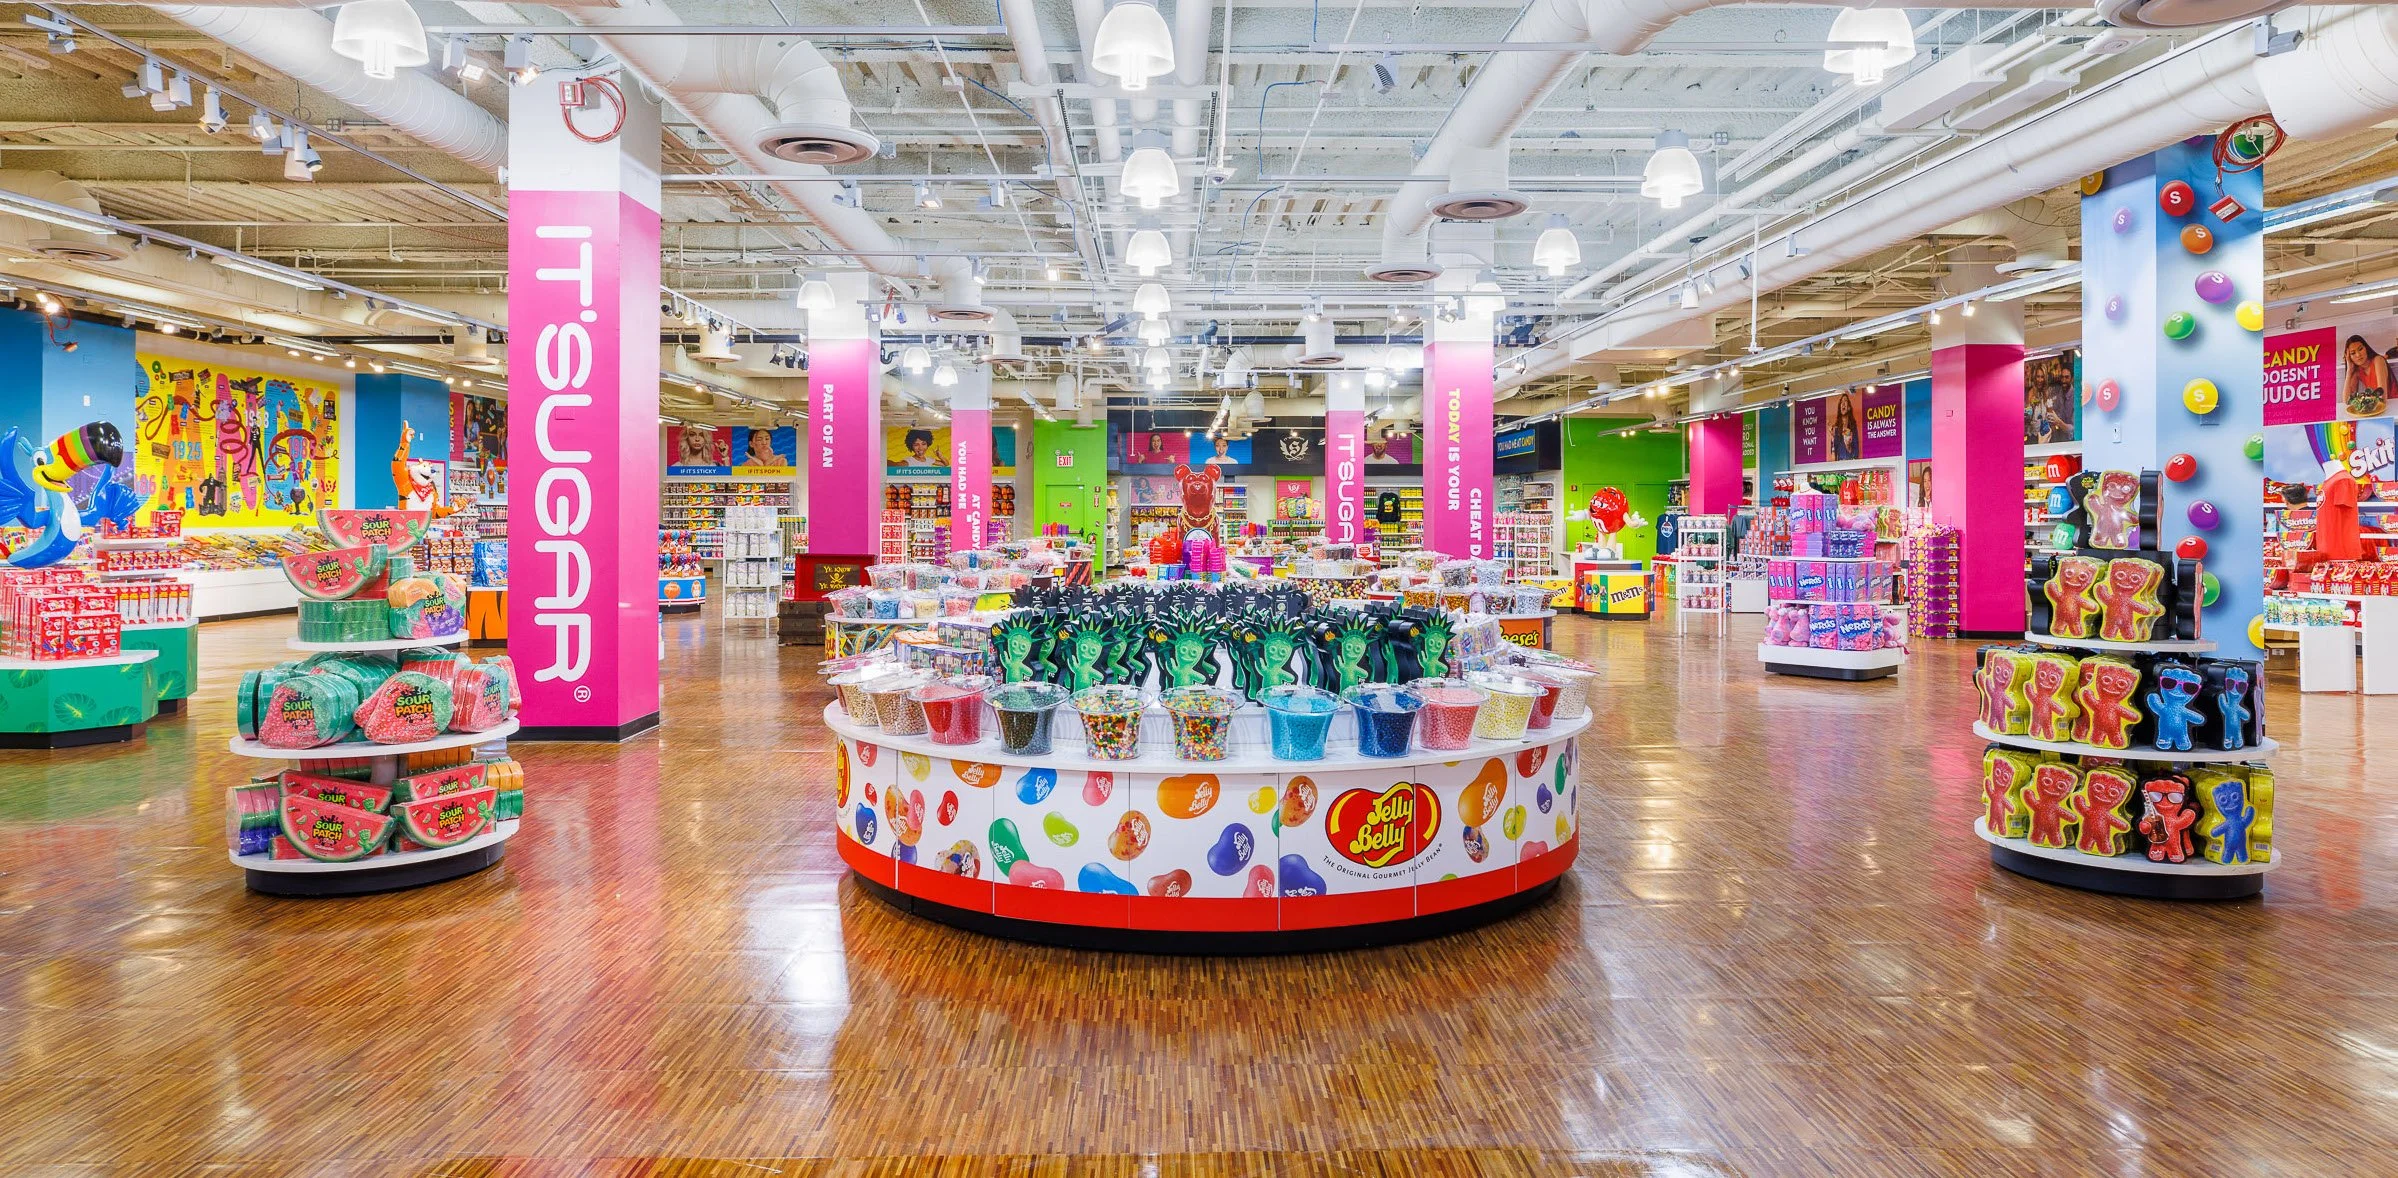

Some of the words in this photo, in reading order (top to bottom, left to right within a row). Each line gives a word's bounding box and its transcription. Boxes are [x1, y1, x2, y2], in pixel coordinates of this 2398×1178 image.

[2169, 190, 2182, 204] S
[2118, 214, 2125, 225] S
[2195, 227, 2206, 238] S
[2211, 272, 2224, 284] S
[2110, 300, 2117, 311] S
[2171, 313, 2184, 323] S
[2263, 344, 2321, 369] CANDY
[2103, 387, 2111, 400] S
[2194, 389, 2205, 402] S
[2263, 381, 2321, 405] JUDGE
[822, 383, 834, 422] PART
[1448, 388, 1461, 443] TODAY
[1804, 406, 1816, 416] YOU
[1866, 404, 1896, 420] CANDY
[1802, 416, 1818, 426] KNOW
[1867, 421, 1873, 430] IS
[1873, 418, 1896, 429] ALWAYS
[822, 424, 834, 444] OF
[1804, 427, 1816, 437] YOU
[1867, 431, 1877, 439] THE
[1877, 429, 1897, 438] ANSWER
[1802, 437, 1818, 446] WANT
[171, 440, 202, 461] 1925
[534, 225, 598, 683] IT'SUGAR
[822, 446, 834, 468] AN
[958, 441, 967, 467] YOU
[1448, 446, 1460, 462] IS
[1807, 447, 1813, 456] IT
[1058, 456, 1072, 466] EXIT
[2173, 456, 2185, 466] S
[958, 467, 967, 490] HAD
[1337, 433, 1356, 549] IT'SUGA
[1448, 465, 1461, 511] YOUR
[958, 493, 967, 510] ME
[972, 494, 981, 509] AT
[2201, 502, 2213, 514] S
[1470, 487, 1482, 541] CHEAT
[362, 520, 390, 530] SOUR
[972, 510, 981, 550] CANDY
[361, 528, 392, 538] PATCH
[2186, 537, 2197, 546] S
[316, 563, 340, 574] SOUR
[317, 570, 343, 582] PATCH
[424, 597, 445, 608] SOUR
[424, 604, 446, 615] PATCH
[1500, 624, 1539, 647] eese's
[283, 699, 312, 711] SOUR
[397, 692, 432, 706] SOUR
[282, 709, 314, 721] PATCH
[395, 703, 432, 717] PATCH
[969, 762, 985, 778] Jelly
[962, 771, 980, 785] Belly
[439, 781, 459, 794] SOUR
[1194, 781, 1213, 800] Jelly
[318, 792, 346, 803] SOUR
[1366, 781, 1414, 827] Jelly
[439, 807, 464, 820] SOUR
[1188, 798, 1210, 815] Belly
[315, 820, 343, 832] SOUR
[439, 814, 465, 829] PATCH
[313, 828, 343, 841] PATCH
[991, 840, 1004, 862] Belly
[1349, 823, 1405, 869] Belly
[999, 845, 1015, 863] Jelly
[1323, 855, 1335, 868] THE
[1336, 864, 1370, 879] ORIGINAL
[1373, 869, 1406, 880] GOURMET
[1408, 861, 1425, 874] JELLY
[1425, 848, 1441, 863] BEAN
